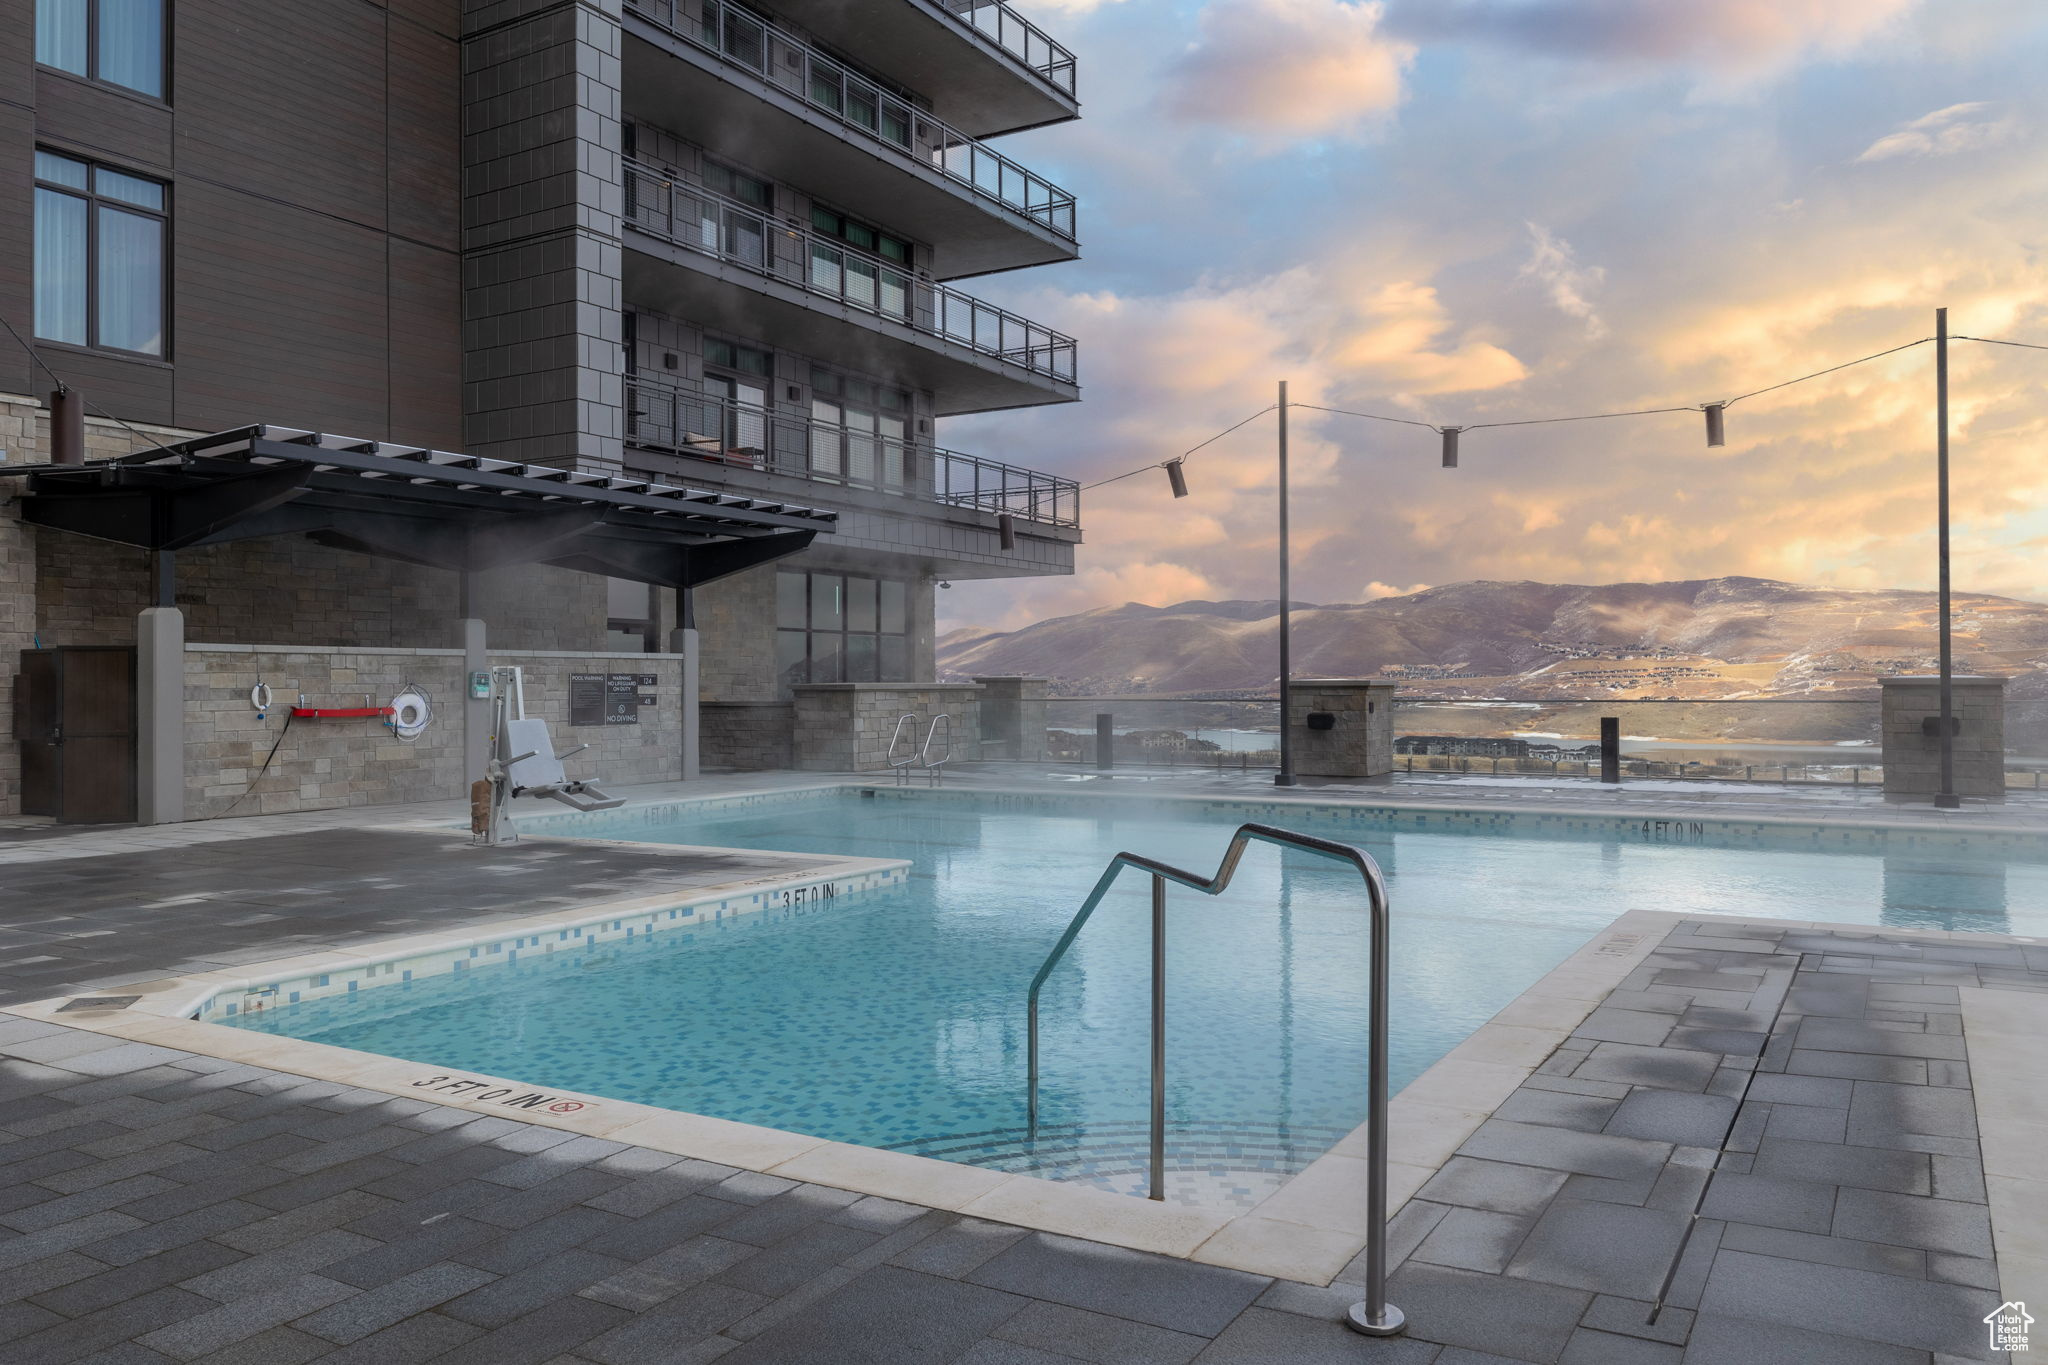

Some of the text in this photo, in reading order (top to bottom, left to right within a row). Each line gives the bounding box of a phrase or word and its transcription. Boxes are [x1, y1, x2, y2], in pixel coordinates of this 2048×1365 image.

[617, 714, 636, 722] DIVING
[1642, 820, 1650, 832] 4
[1655, 821, 1670, 833] FT
[1689, 822, 1704, 834] IN
[783, 891, 790, 908] 3
[794, 887, 807, 904] FT
[822, 882, 834, 899] IN
[412, 1076, 450, 1087] 3
[433, 1080, 490, 1095] FT
[501, 1093, 557, 1109] IN
